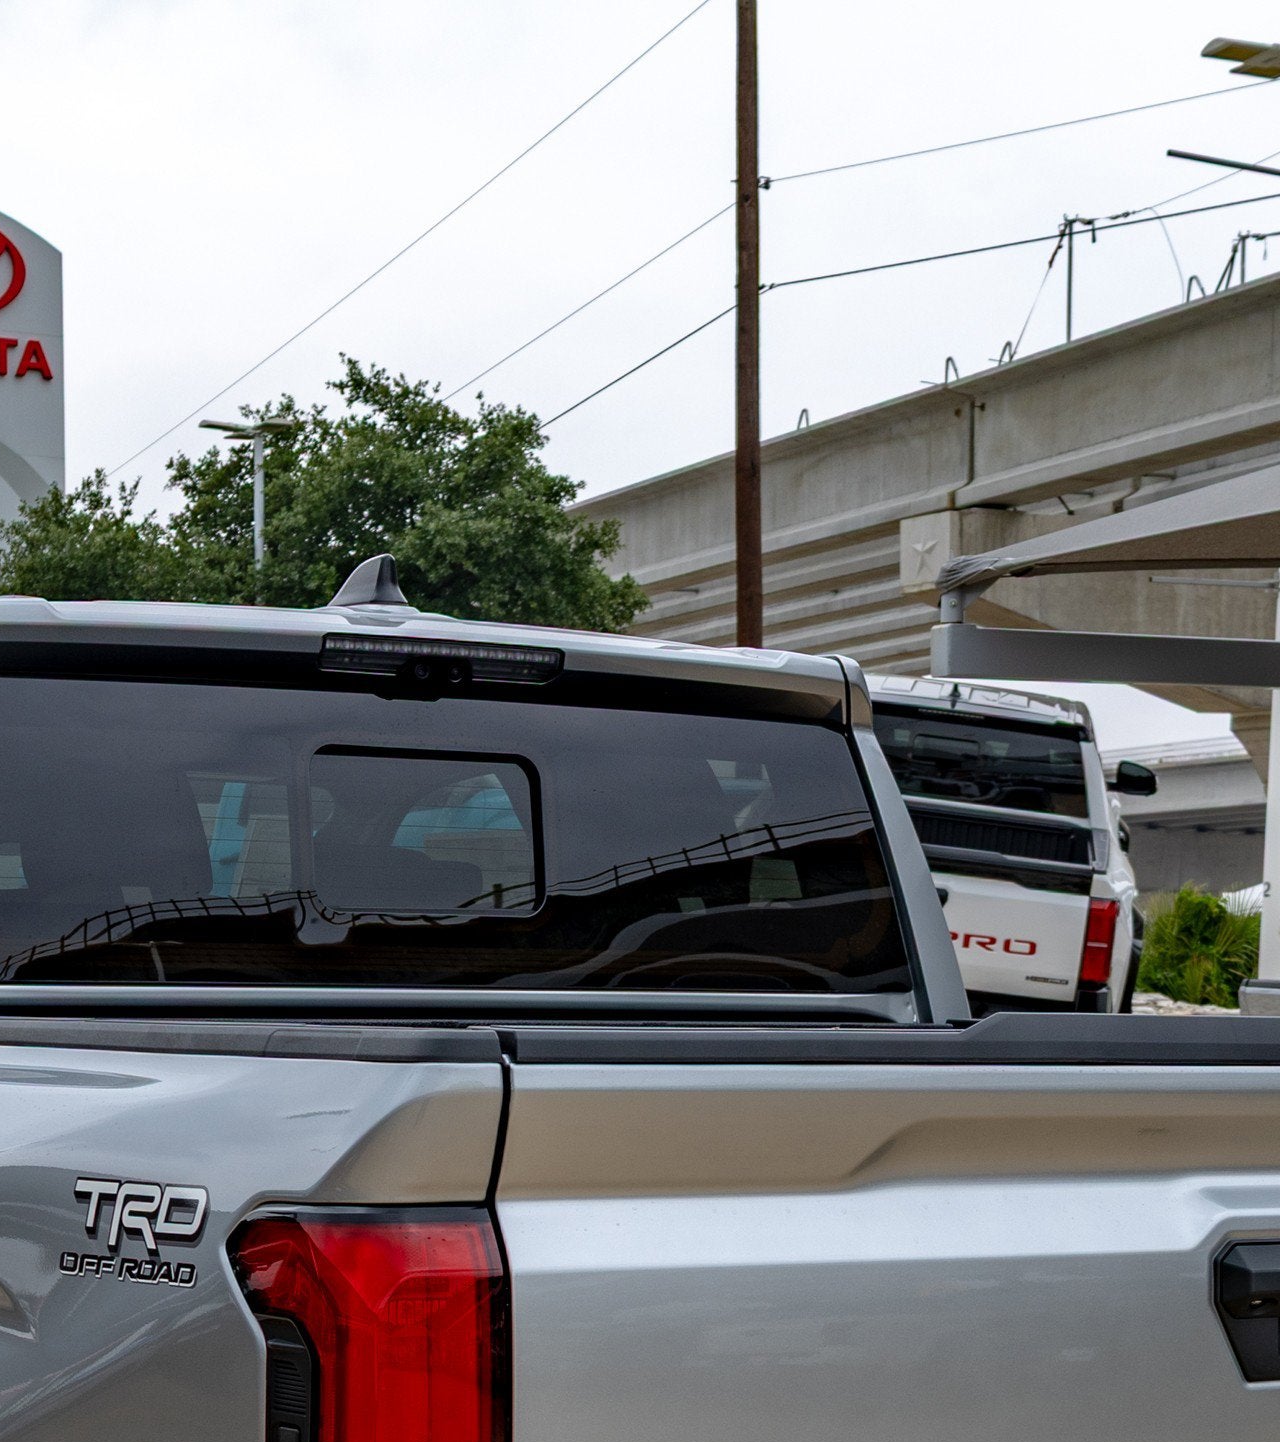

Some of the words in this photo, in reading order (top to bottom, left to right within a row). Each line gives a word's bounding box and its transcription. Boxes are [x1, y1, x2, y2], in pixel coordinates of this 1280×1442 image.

[74, 1177, 209, 1257] TRD
[59, 1251, 116, 1279] OFF
[118, 1258, 197, 1287] ROAD
